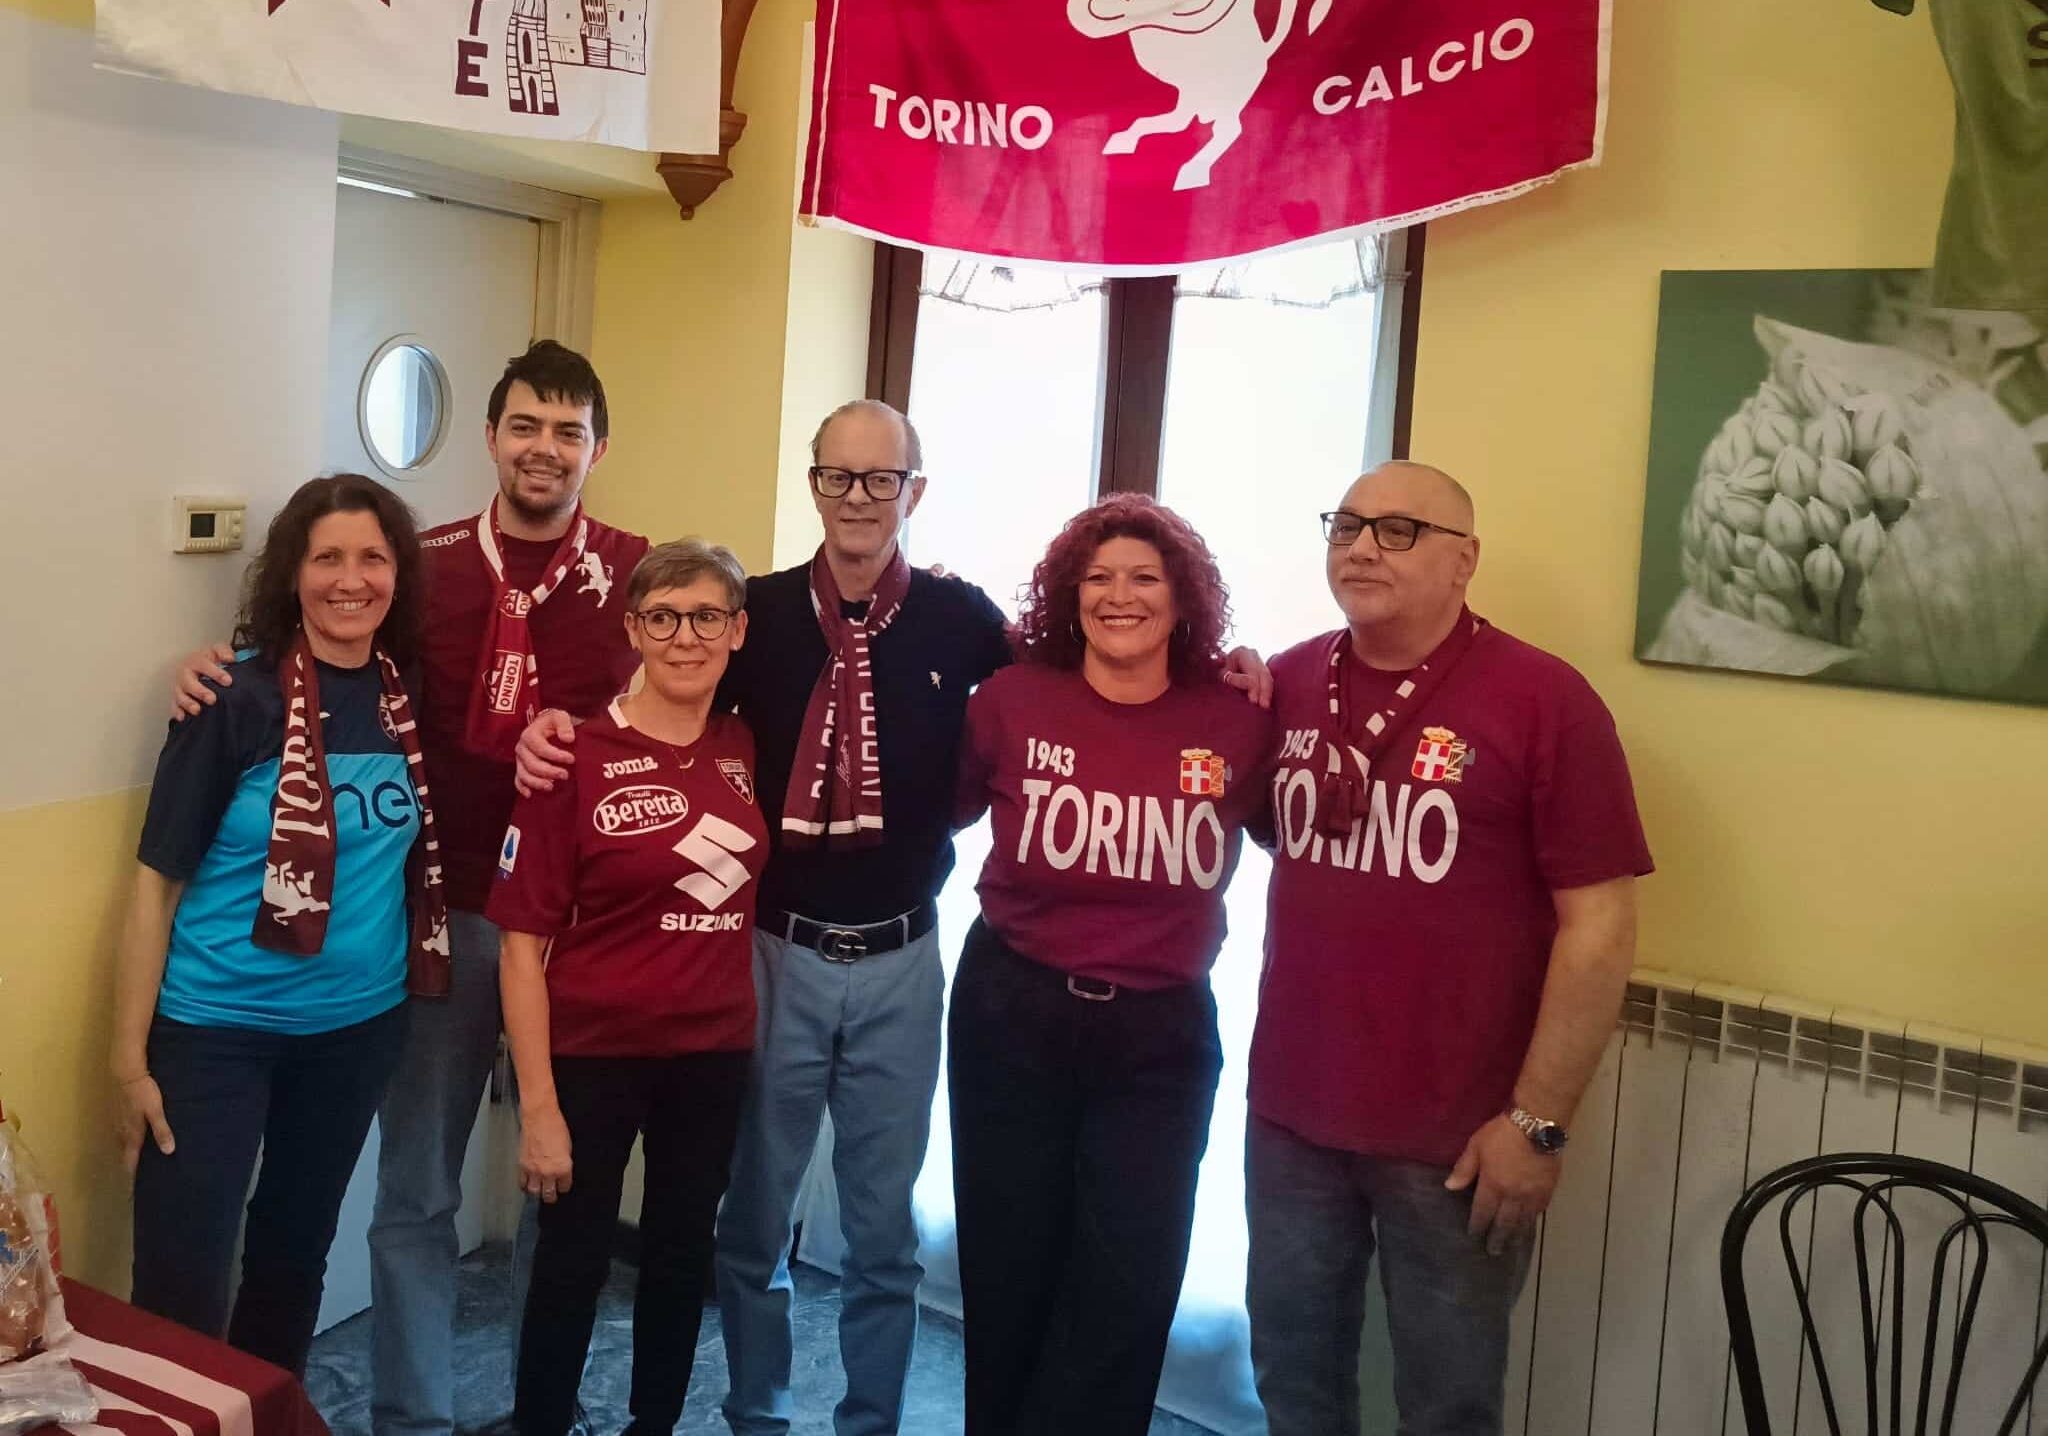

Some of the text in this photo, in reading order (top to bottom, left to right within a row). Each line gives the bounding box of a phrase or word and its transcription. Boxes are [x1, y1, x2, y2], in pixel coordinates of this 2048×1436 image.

[1311, 17, 1537, 117] CALCIO
[867, 83, 1055, 151] TORINO
[420, 529, 471, 549] appa
[499, 659, 519, 707] TORINO
[1027, 738, 1076, 777] 1943
[1279, 729, 1320, 760] 1943
[599, 794, 687, 832] Beretta
[1017, 779, 1225, 890] TORINO
[660, 912, 745, 932] SUZUKI
